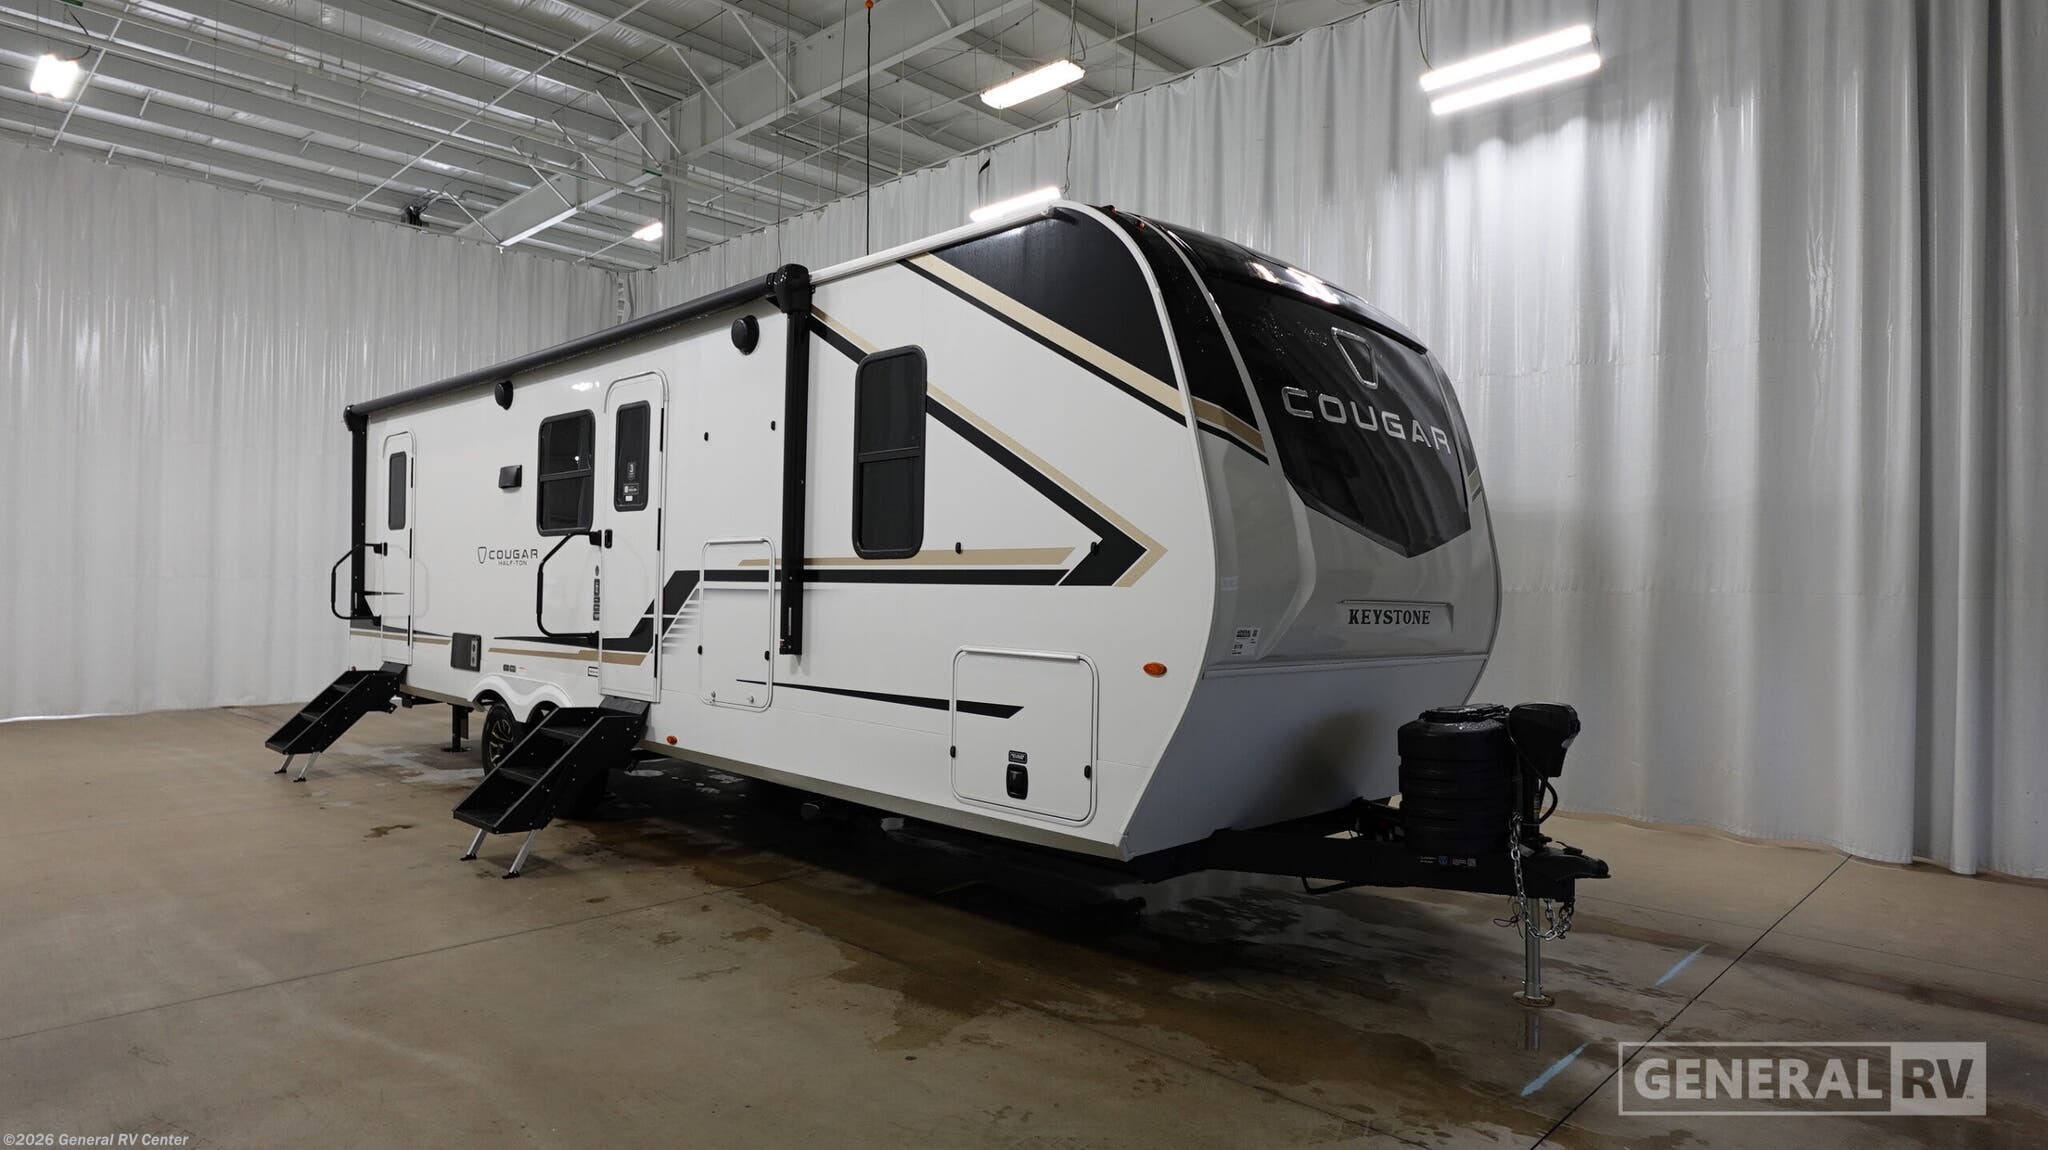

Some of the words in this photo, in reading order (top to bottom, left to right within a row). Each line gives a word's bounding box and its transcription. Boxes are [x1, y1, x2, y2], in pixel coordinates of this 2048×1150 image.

[1281, 386, 1451, 455] COUGAR
[489, 549, 538, 560] COUGAR
[1348, 608, 1431, 625] KEYSTONE
